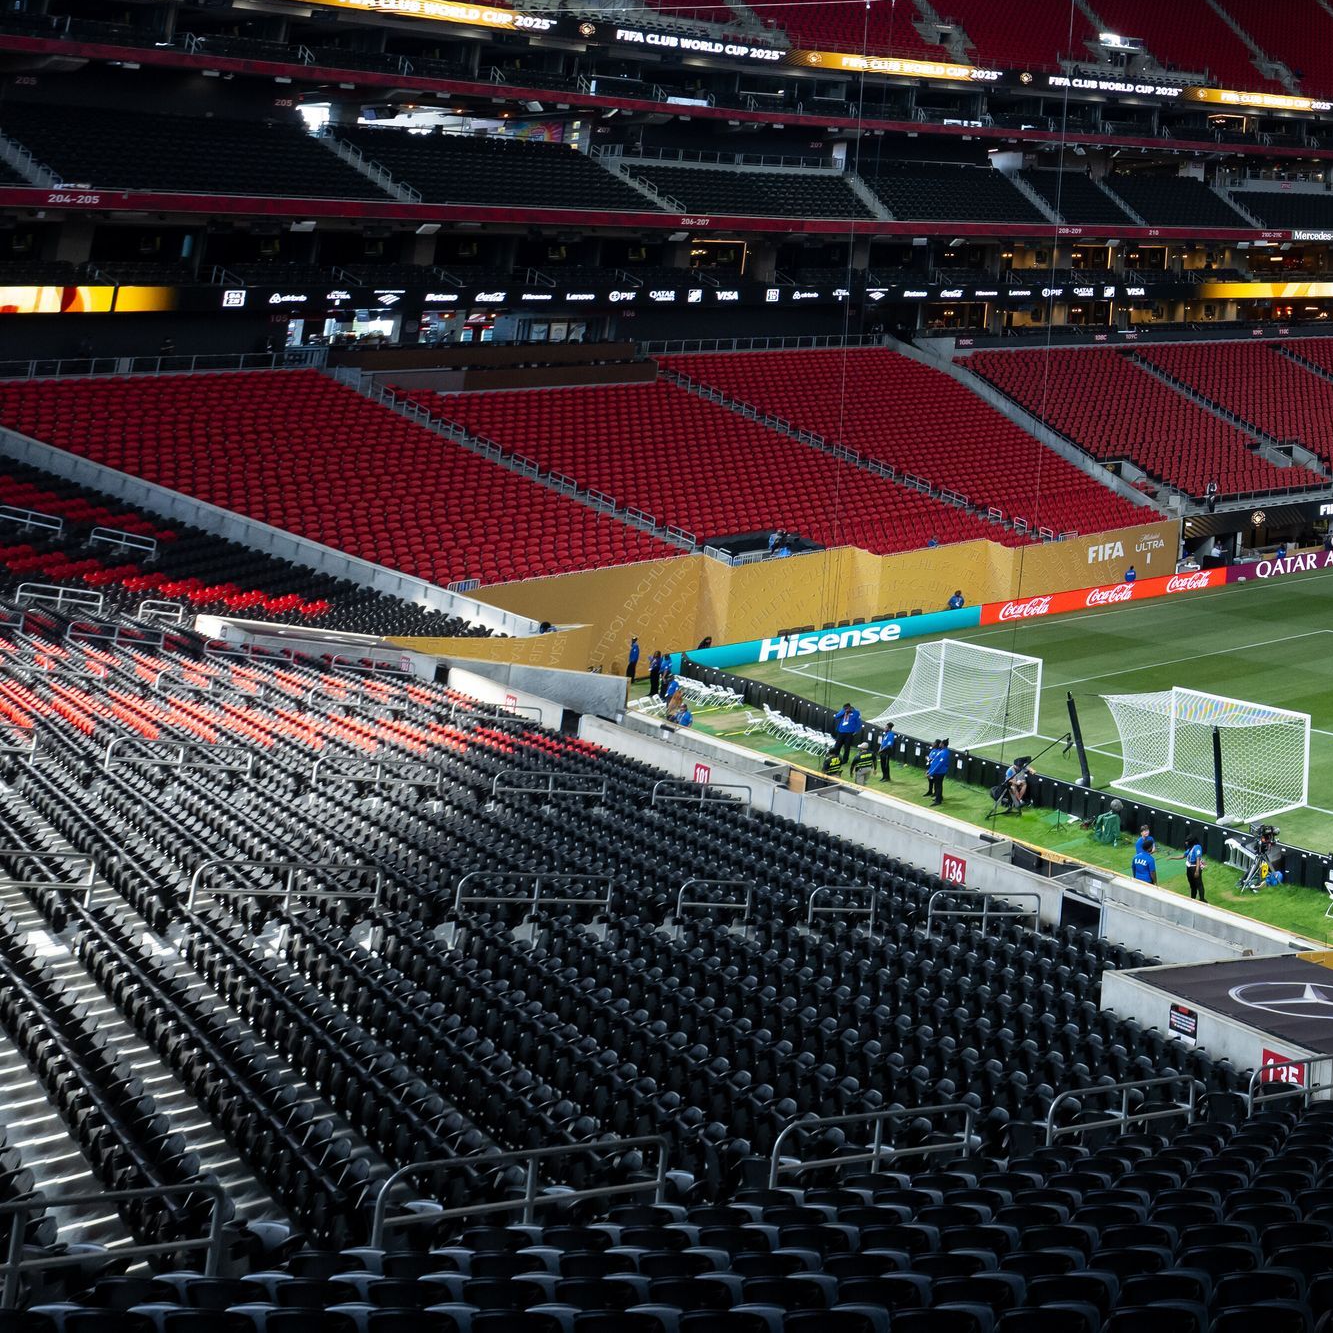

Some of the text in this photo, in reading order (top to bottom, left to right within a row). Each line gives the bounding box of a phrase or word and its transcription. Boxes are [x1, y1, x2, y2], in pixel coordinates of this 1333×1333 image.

[617, 29, 644, 43] FIFA
[646, 34, 678, 47] CLUB
[681, 38, 723, 53] WORLD
[725, 46, 749, 56] CUP
[1050, 76, 1070, 87] FIFA
[1072, 79, 1098, 88] CLUB
[1100, 82, 1134, 92] WORLD
[1136, 85, 1154, 94] CUP
[48, 194, 100, 204] 204-205
[681, 218, 710, 226] 206-207
[620, 292, 636, 300] PIF
[716, 291, 738, 300] VISA
[1088, 541, 1124, 564] FIFA
[1136, 539, 1164, 552] ULTRA
[1256, 554, 1317, 578] QATAR
[1166, 571, 1211, 593] Coca-Cola
[1087, 583, 1135, 606] Coca-Cola
[999, 596, 1052, 621] Coca-Cola
[758, 622, 901, 663] Hisense
[695, 768, 709, 783] 101
[944, 859, 962, 882] 136
